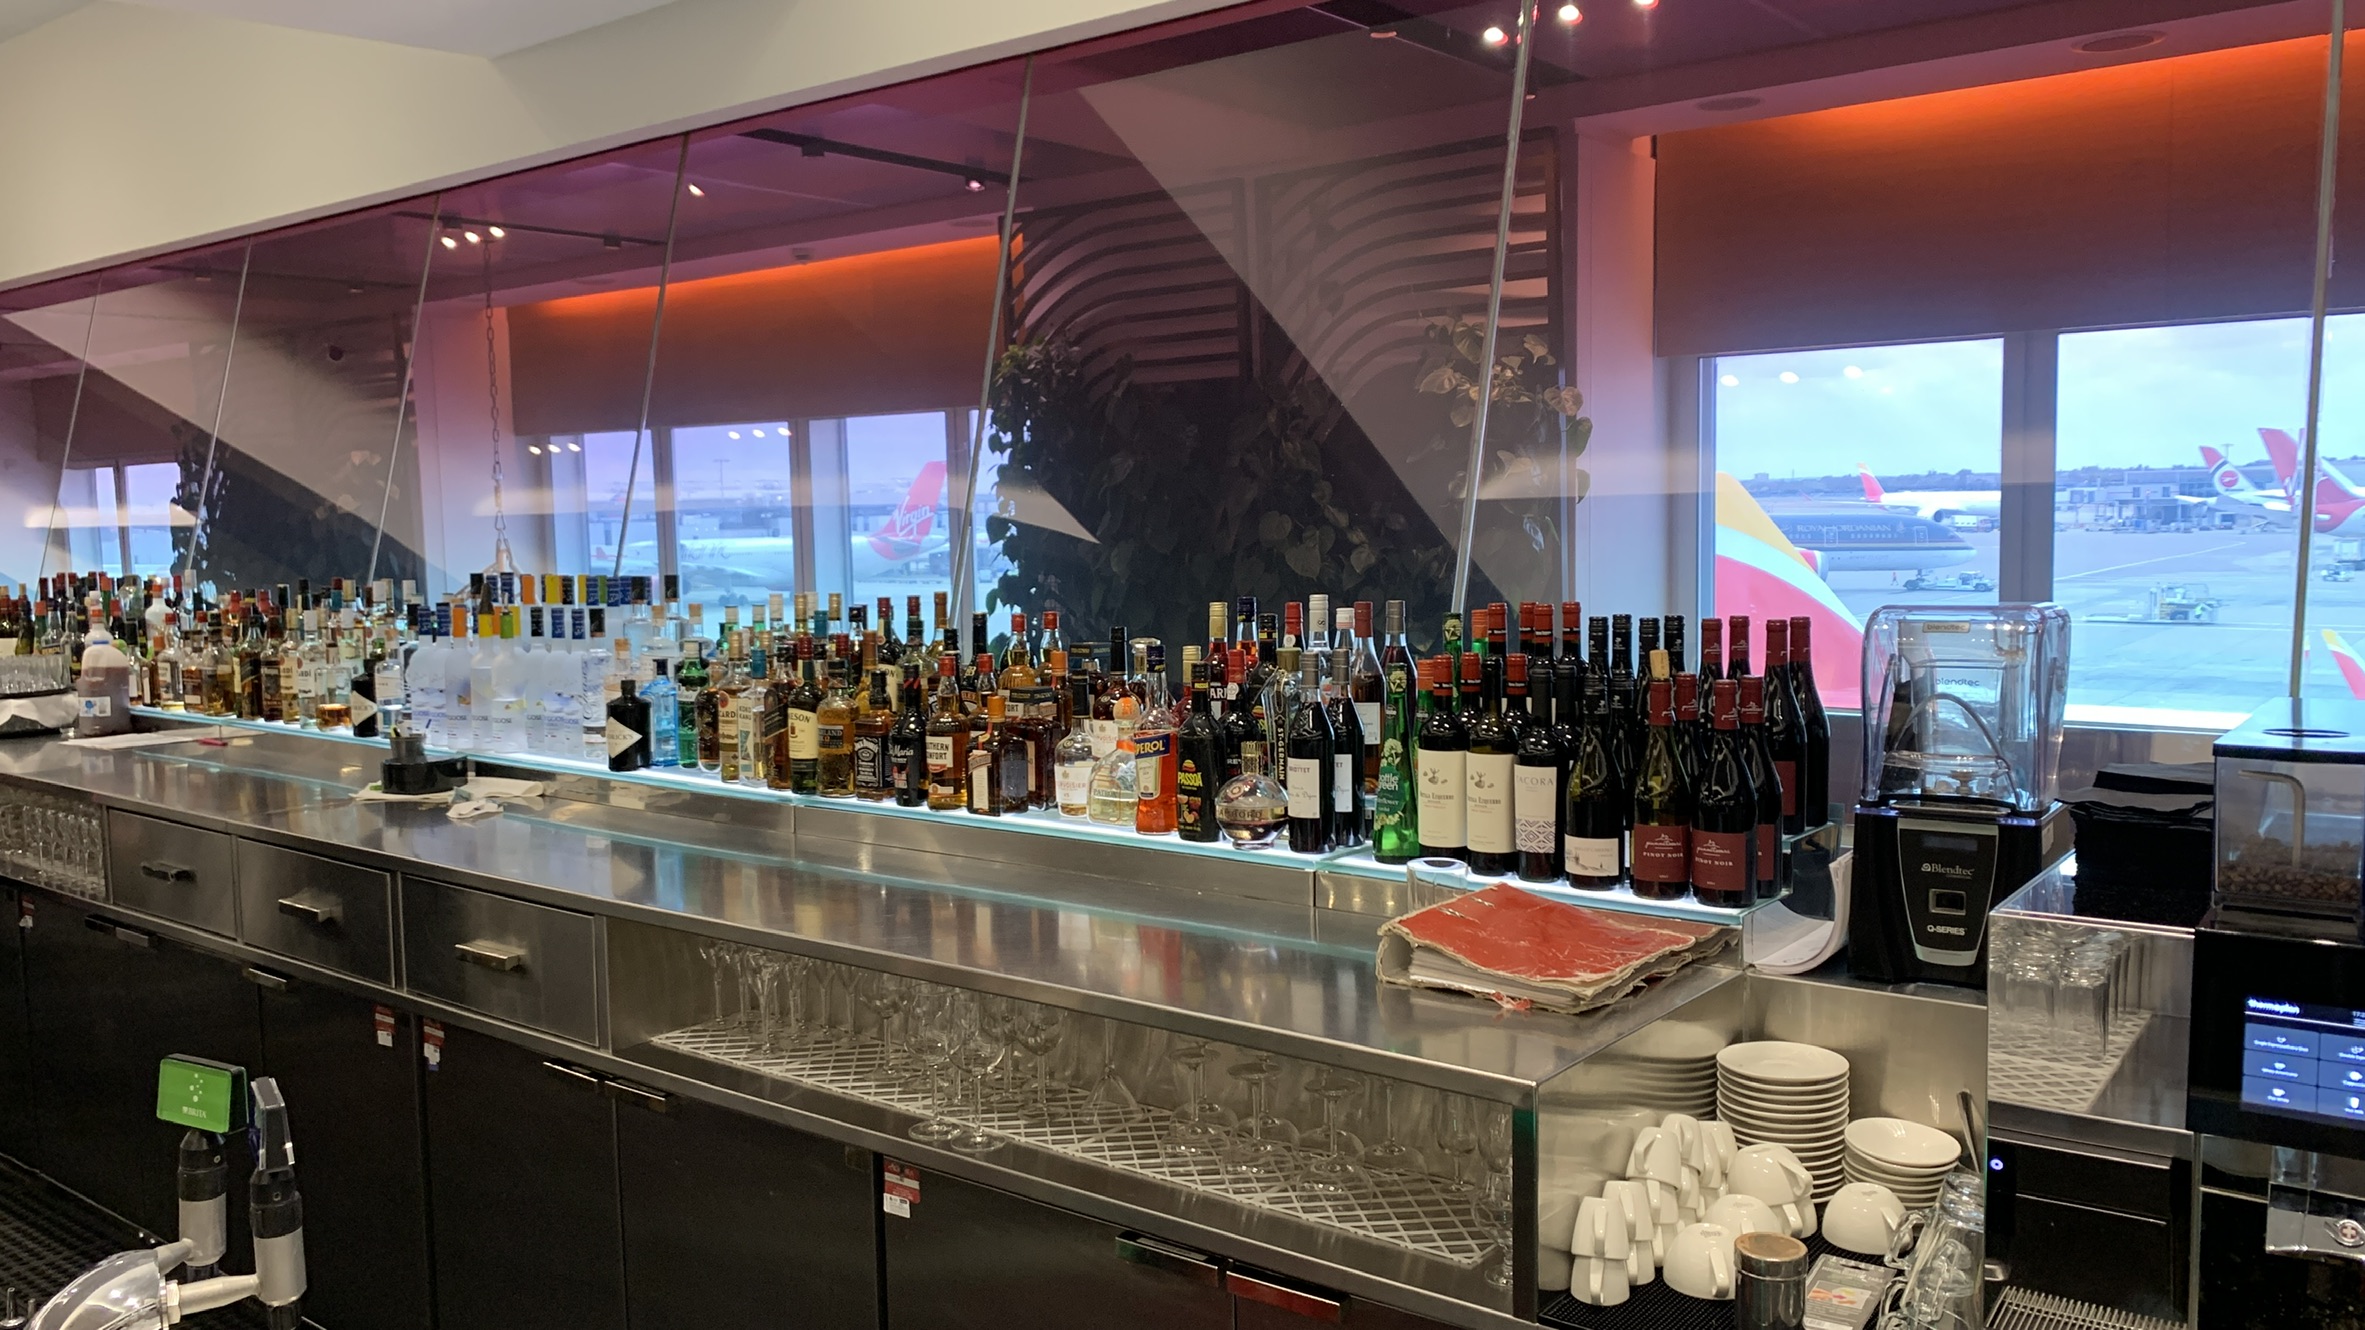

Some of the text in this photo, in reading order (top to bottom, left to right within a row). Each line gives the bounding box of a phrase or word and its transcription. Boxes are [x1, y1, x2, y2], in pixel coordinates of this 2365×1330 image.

[893, 495, 935, 537] Virgin
[1931, 863, 1974, 875] Blendtec
[1927, 924, 1966, 937] Q-SERIES
